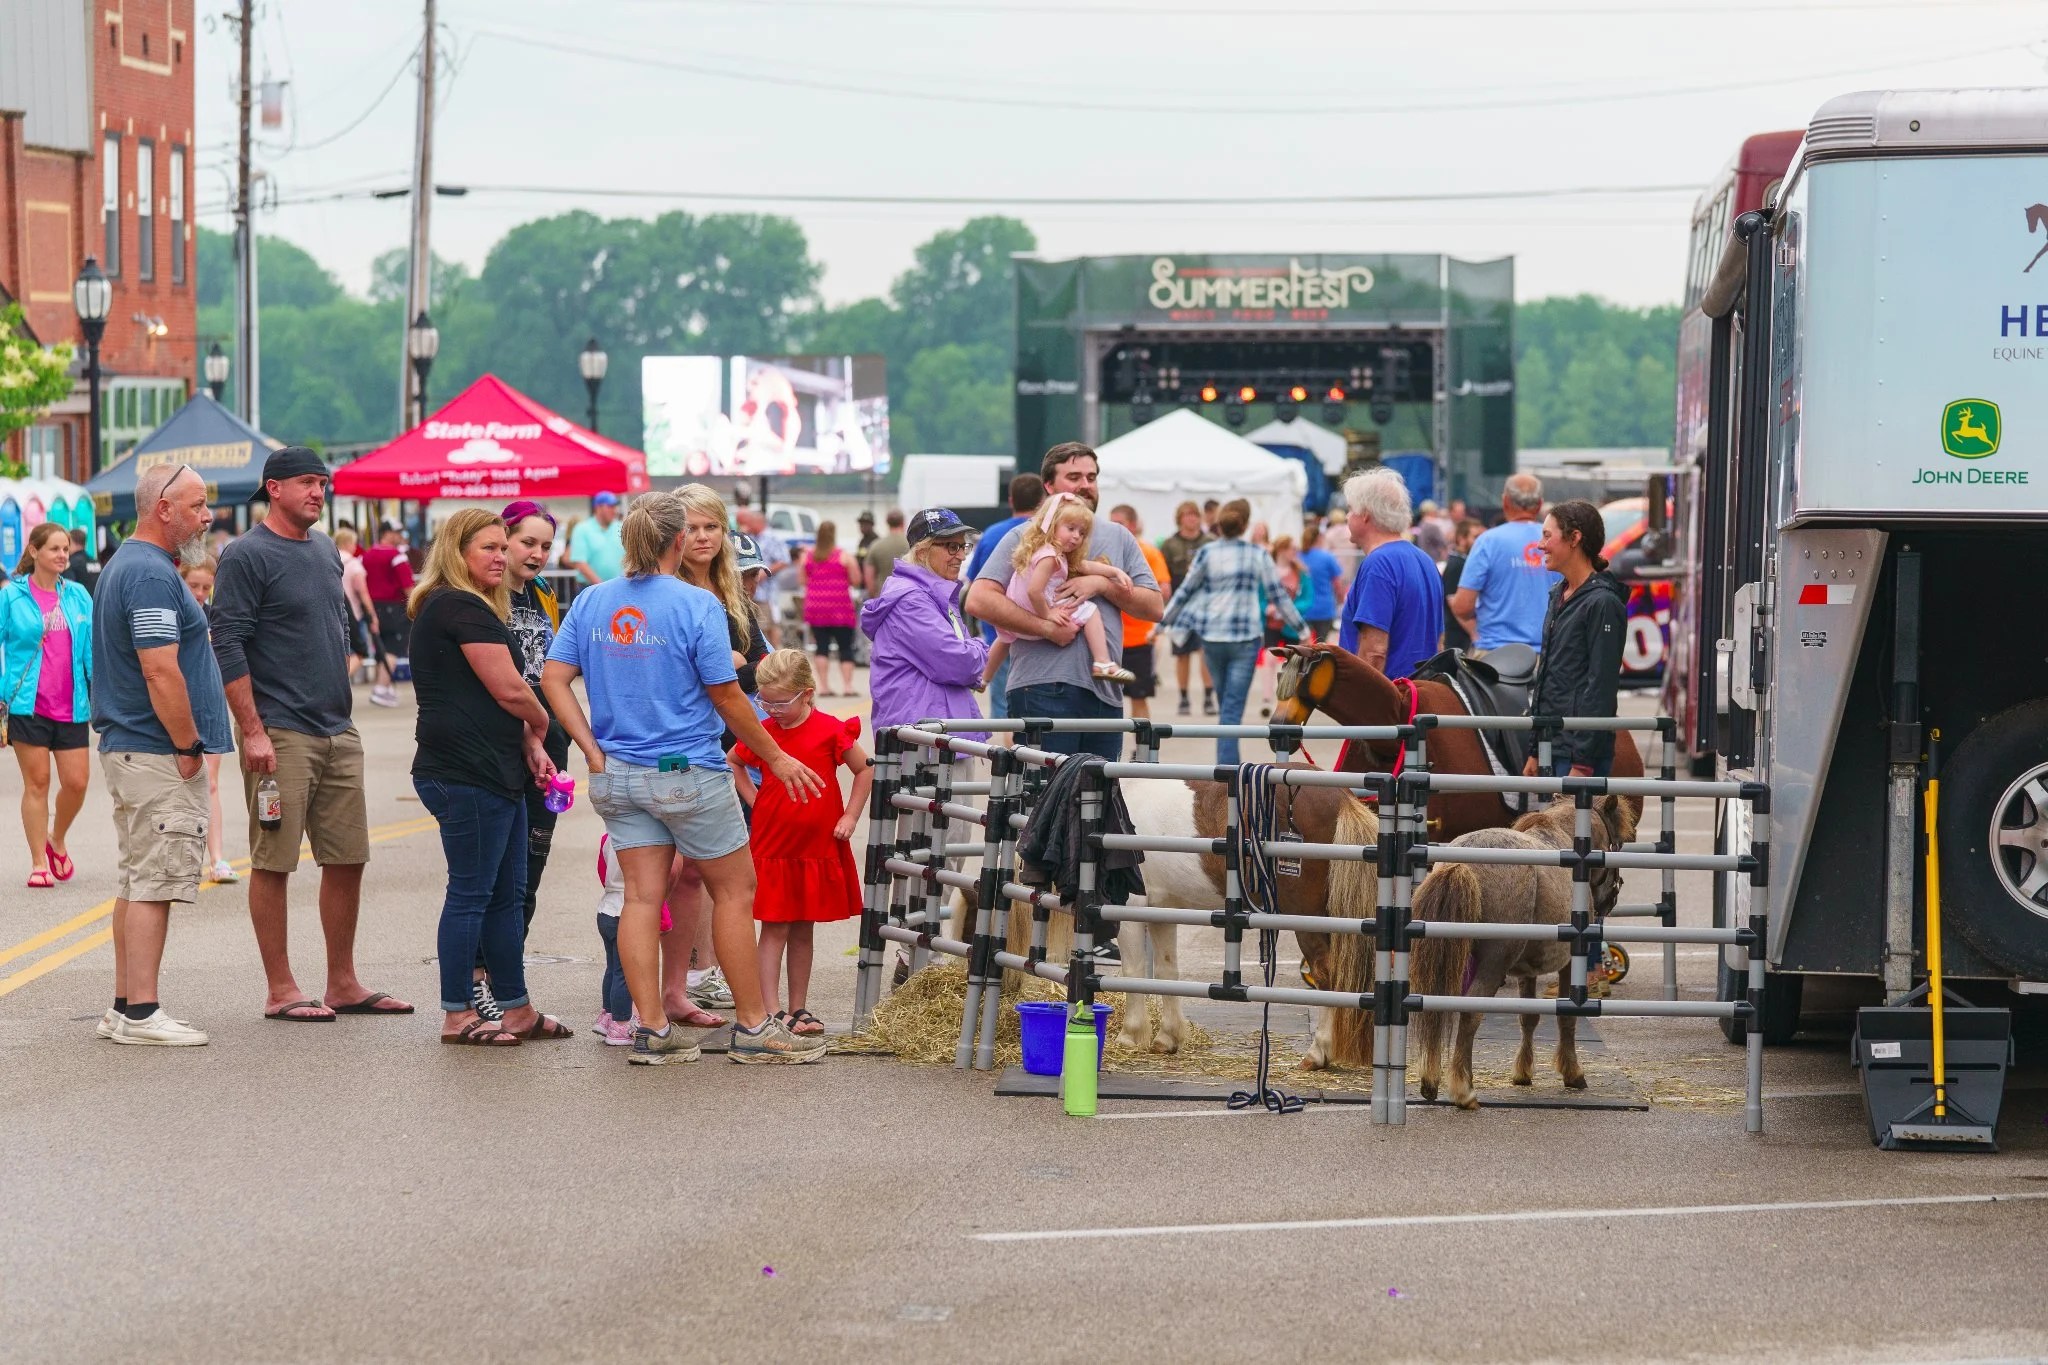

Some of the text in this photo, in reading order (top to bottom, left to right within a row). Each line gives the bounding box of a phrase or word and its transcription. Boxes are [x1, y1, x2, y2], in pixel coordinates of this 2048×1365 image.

[1149, 257, 1374, 309] SUMMERFEST
[1993, 347, 2044, 362] EQUINE
[141, 446, 248, 468] HENDERSON
[399, 471, 440, 486] Robert
[523, 466, 559, 482] Agent
[1912, 468, 2029, 485] JOHN DEERE
